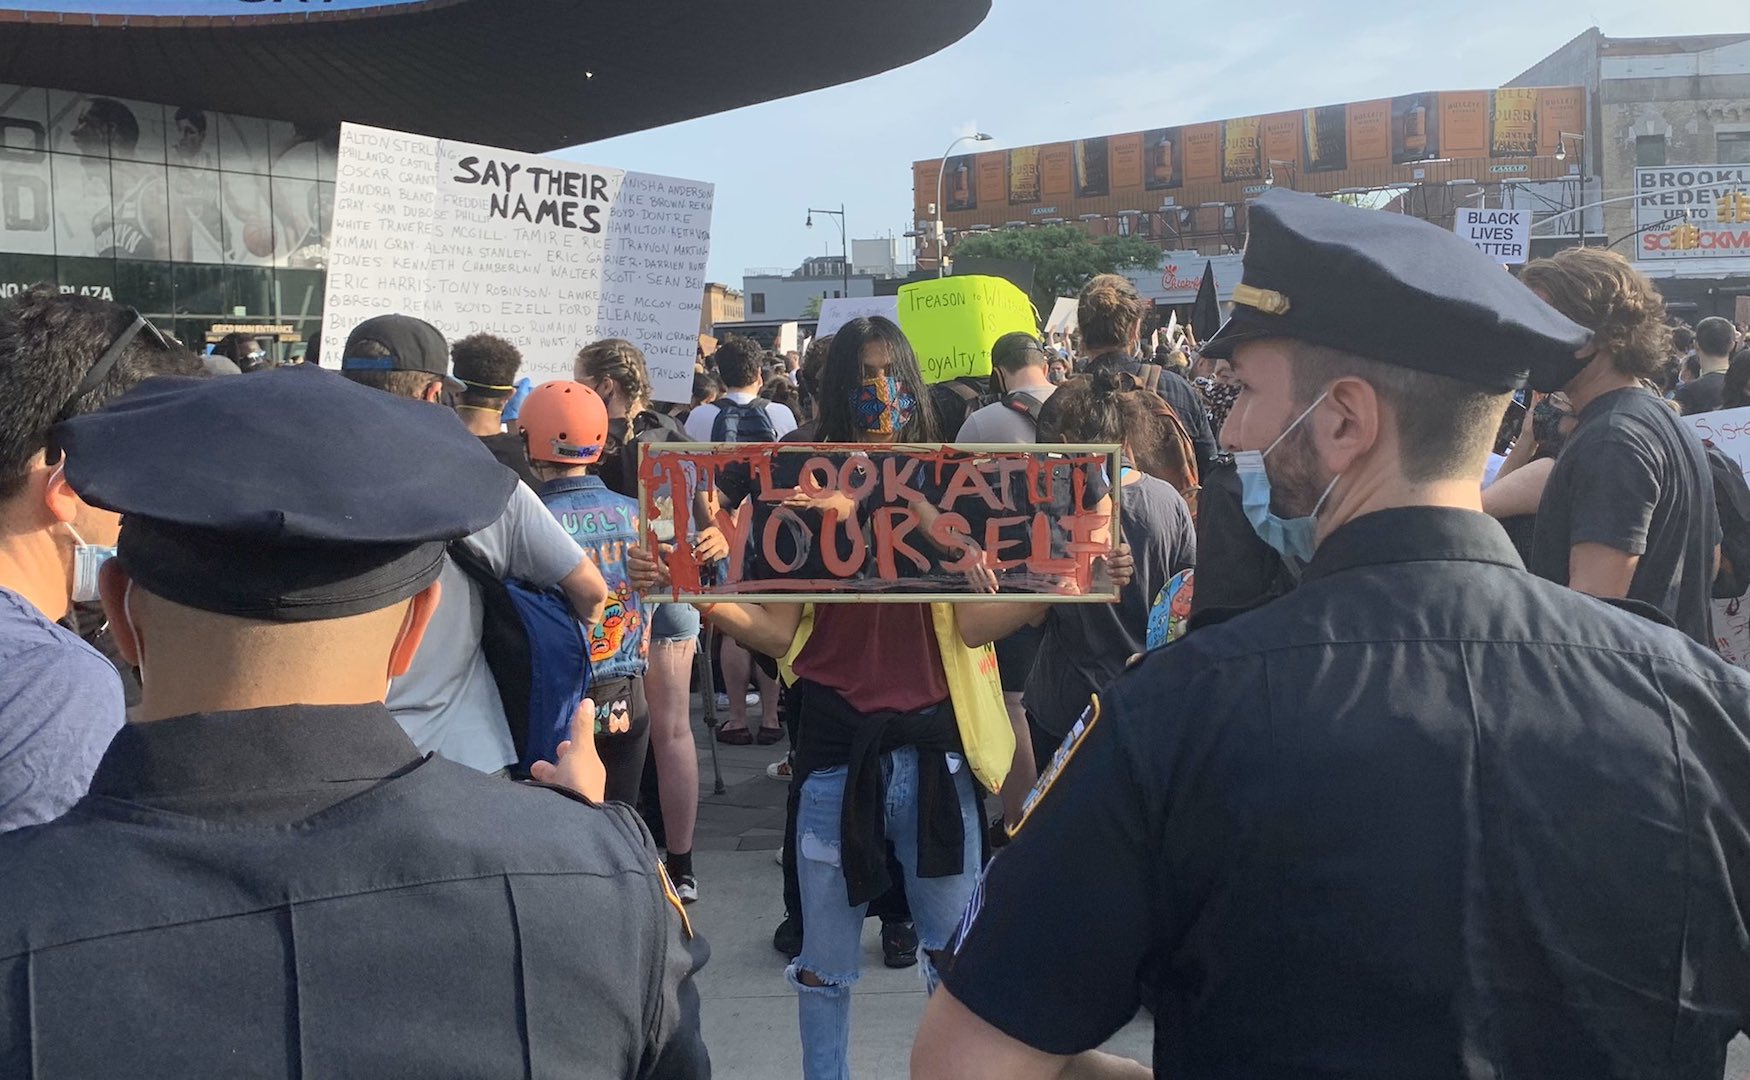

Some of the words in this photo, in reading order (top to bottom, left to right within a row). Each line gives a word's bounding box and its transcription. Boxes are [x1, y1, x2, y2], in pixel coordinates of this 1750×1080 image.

[345, 130, 390, 149] ALTON
[342, 164, 393, 181] OSCAR
[399, 172, 438, 185] GRANT
[454, 156, 521, 193] SAY
[526, 167, 610, 203] THEIR
[339, 181, 392, 198] SANDRA
[443, 194, 489, 209] FREDDIE
[612, 174, 665, 193] TANISHA
[668, 185, 713, 200] ANDERSON
[338, 198, 365, 211] GRAY
[373, 202, 396, 215] SAM
[403, 205, 449, 220] DUBOSE
[612, 191, 644, 205] MIKE
[649, 196, 686, 209] BROWN
[490, 193, 602, 234] NAMES
[610, 206, 636, 218] BOYD
[640, 209, 693, 224] DONTRE
[1468, 211, 1520, 225] BLACK
[1690, 208, 1709, 219] TO
[336, 219, 372, 231] WHITE
[452, 226, 503, 241] MCGILL
[582, 235, 612, 250] RICE
[619, 238, 670, 255] TRAYVON
[607, 220, 666, 235] HAMILTON
[1471, 226, 1514, 241] LIVES
[336, 236, 378, 250] KIMANI
[384, 237, 415, 251] GRAY
[424, 241, 473, 257] ALAYNA
[479, 247, 528, 259] STANLEY
[547, 249, 579, 263] ERIC
[586, 251, 638, 268] GARNER
[644, 258, 684, 271] DARRIEN
[331, 252, 383, 268] JONES
[392, 255, 455, 271] KENNETH
[551, 265, 598, 280] WALTER
[603, 269, 636, 283] SCOTT
[646, 272, 680, 288] SEAN
[685, 275, 704, 290] BELL
[330, 273, 369, 290] ERIC
[378, 275, 432, 293] HARRIS
[438, 279, 480, 295] TONY
[485, 282, 549, 299] ROBINSON
[558, 288, 625, 304] LAWRENCE
[973, 293, 983, 301] to
[402, 297, 444, 312] REKIA
[454, 302, 492, 313] BOYD
[501, 301, 552, 315] EZELL
[559, 303, 592, 316] FORD
[597, 305, 661, 326] ELEANOR
[468, 321, 521, 334] DIALLO
[530, 320, 577, 334] RUMAIN
[585, 324, 629, 337] BRISON
[636, 328, 663, 340] JOHN
[540, 336, 567, 348] HUNT
[642, 342, 695, 357] POWELL
[650, 366, 687, 380] TAYLOR
[757, 455, 926, 503] LOOK
[938, 456, 1029, 511] AT
[561, 505, 632, 536] UGLY
[714, 500, 1111, 593] YOURSELF
